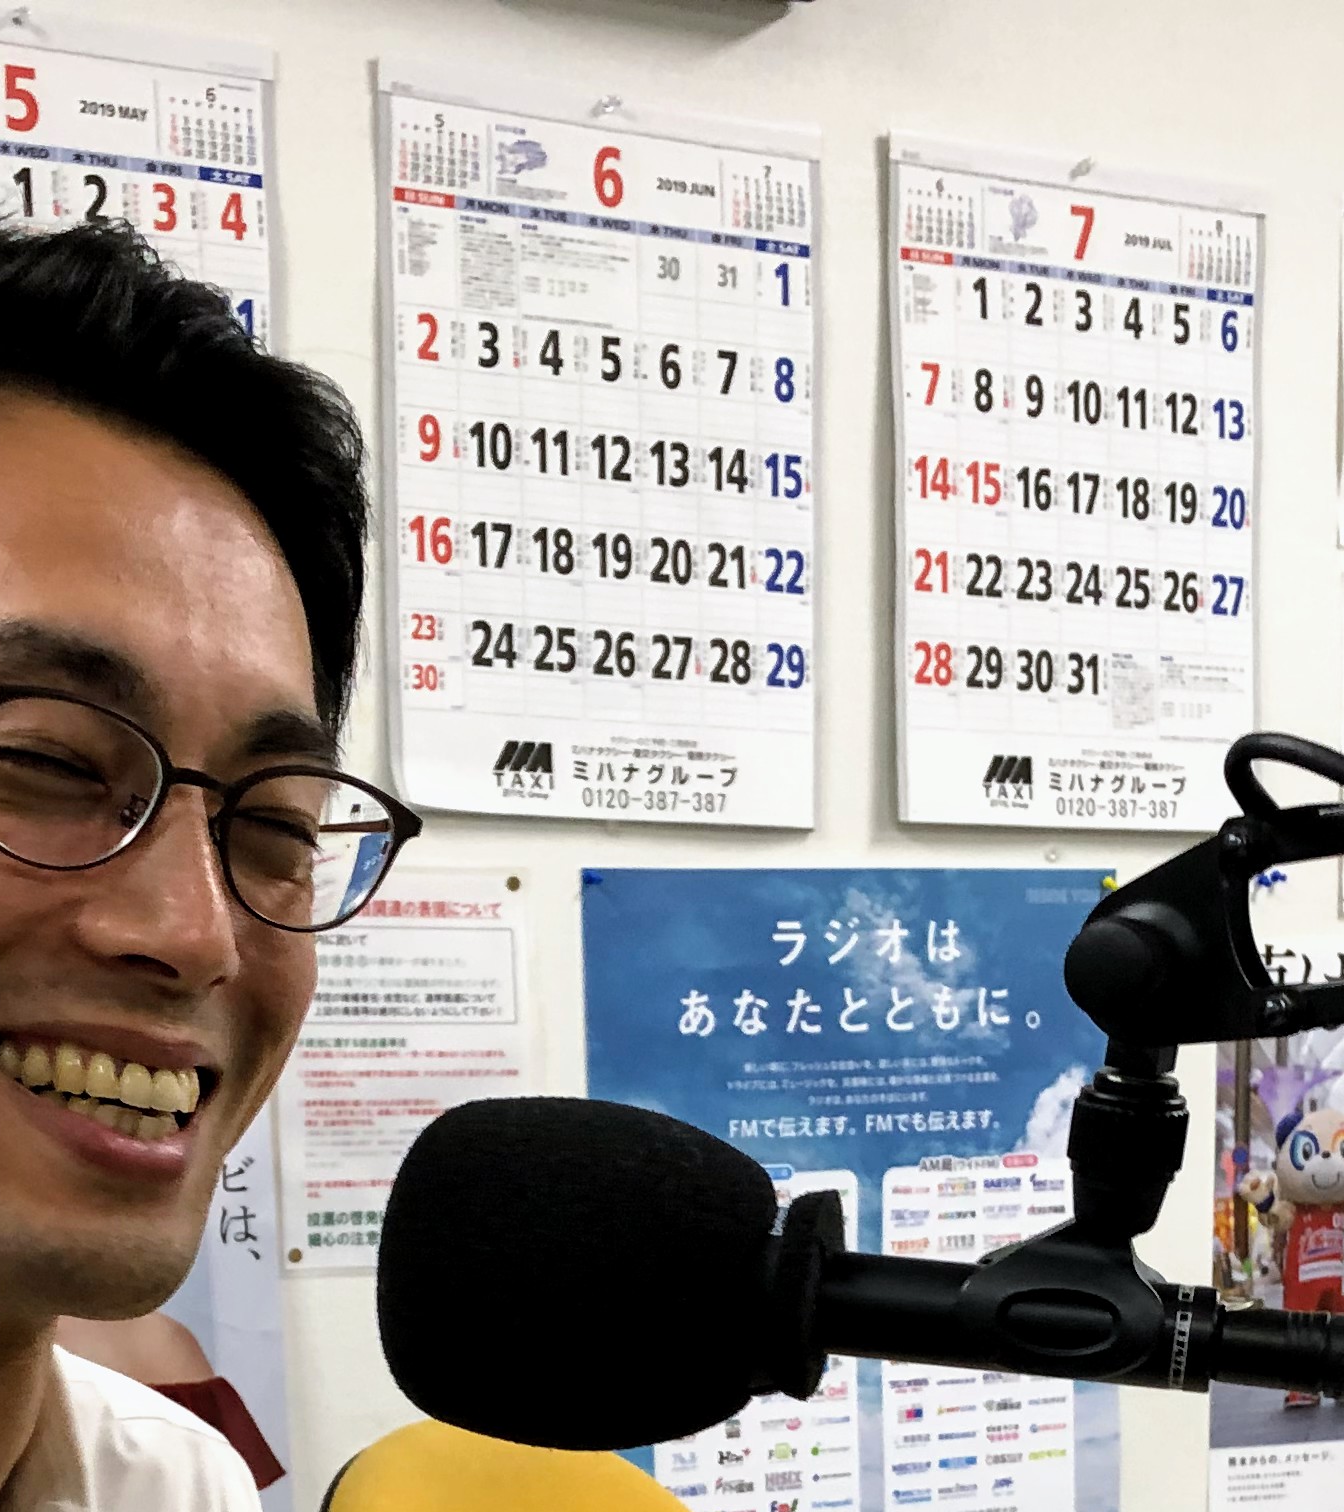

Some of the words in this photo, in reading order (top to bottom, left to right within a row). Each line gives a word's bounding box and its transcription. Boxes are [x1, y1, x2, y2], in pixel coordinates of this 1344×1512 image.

[4, 64, 39, 132] 5
[80, 100, 116, 118] 2019
[118, 106, 148, 122] MAY
[434, 114, 445, 128] 5
[14, 145, 49, 159] WED
[89, 154, 118, 167] THU
[593, 146, 624, 208] 6
[657, 177, 687, 193] 2019
[690, 182, 715, 197] JUN
[763, 165, 772, 177] 7
[13, 167, 34, 218] 1
[83, 174, 108, 223] 2
[152, 183, 177, 232] 3
[221, 192, 247, 241] 4
[1070, 205, 1095, 260] 7
[1124, 232, 1150, 247] 2019
[1152, 237, 1172, 251] JUL
[657, 255, 680, 281] 30
[717, 264, 738, 288] 31
[774, 263, 790, 307] 1
[973, 277, 988, 320] 1
[1025, 282, 1043, 327] 2
[1075, 289, 1092, 332] 3
[1123, 297, 1144, 340] 4
[1173, 302, 1190, 345] 5
[1221, 310, 1238, 352] 6
[417, 313, 439, 362] 2
[478, 321, 500, 369] 3
[539, 329, 564, 376] 4
[601, 335, 622, 383] 5
[659, 343, 682, 390] 6
[717, 349, 738, 395] 7
[774, 357, 795, 403] 8
[921, 362, 940, 405] 7
[974, 368, 994, 413] 8
[1025, 374, 1044, 418] 9
[1067, 380, 1102, 425] 10
[1116, 386, 1147, 430] 11
[1165, 392, 1198, 436] 12
[1213, 398, 1245, 441] 13
[418, 414, 441, 462] 9
[468, 421, 513, 471] 10
[531, 427, 569, 476] 11
[590, 434, 632, 482] 12
[649, 440, 690, 488] 13
[708, 446, 749, 494] 14
[764, 453, 803, 499] 15
[914, 456, 951, 500] 14
[966, 461, 1001, 506] 15
[1016, 466, 1052, 512] 16
[1066, 472, 1100, 515] 17
[1116, 477, 1150, 521] 18
[1164, 481, 1197, 525] 19
[1211, 486, 1246, 530] 20
[409, 515, 453, 565] 16
[470, 521, 513, 569] 17
[532, 526, 575, 576] 18
[592, 532, 633, 580] 19
[650, 537, 693, 586] 20
[708, 542, 746, 590] 21
[765, 548, 805, 595] 22
[915, 548, 948, 593] 21
[966, 553, 1003, 598] 22
[1016, 557, 1053, 602] 23
[1066, 561, 1103, 606] 24
[1115, 566, 1151, 610] 25
[1163, 570, 1199, 614] 26
[1212, 574, 1244, 617] 27
[411, 613, 436, 641] 23
[471, 620, 518, 669] 24
[534, 624, 577, 673] 25
[593, 629, 636, 678] 26
[652, 634, 693, 681] 27
[709, 638, 752, 685] 28
[767, 642, 805, 689] 29
[413, 664, 437, 691] 30
[915, 641, 953, 686] 28
[966, 645, 1003, 690] 29
[1017, 649, 1054, 693] 30
[1067, 652, 1099, 695] 31
[493, 772, 554, 790] TAXI
[581, 787, 727, 813] 0120-387-387
[983, 785, 1033, 800] TAXI
[1056, 796, 1178, 819] 0120-387-387
[772, 918, 961, 967] ラジオは
[678, 986, 1042, 1038] あなたとともに。
